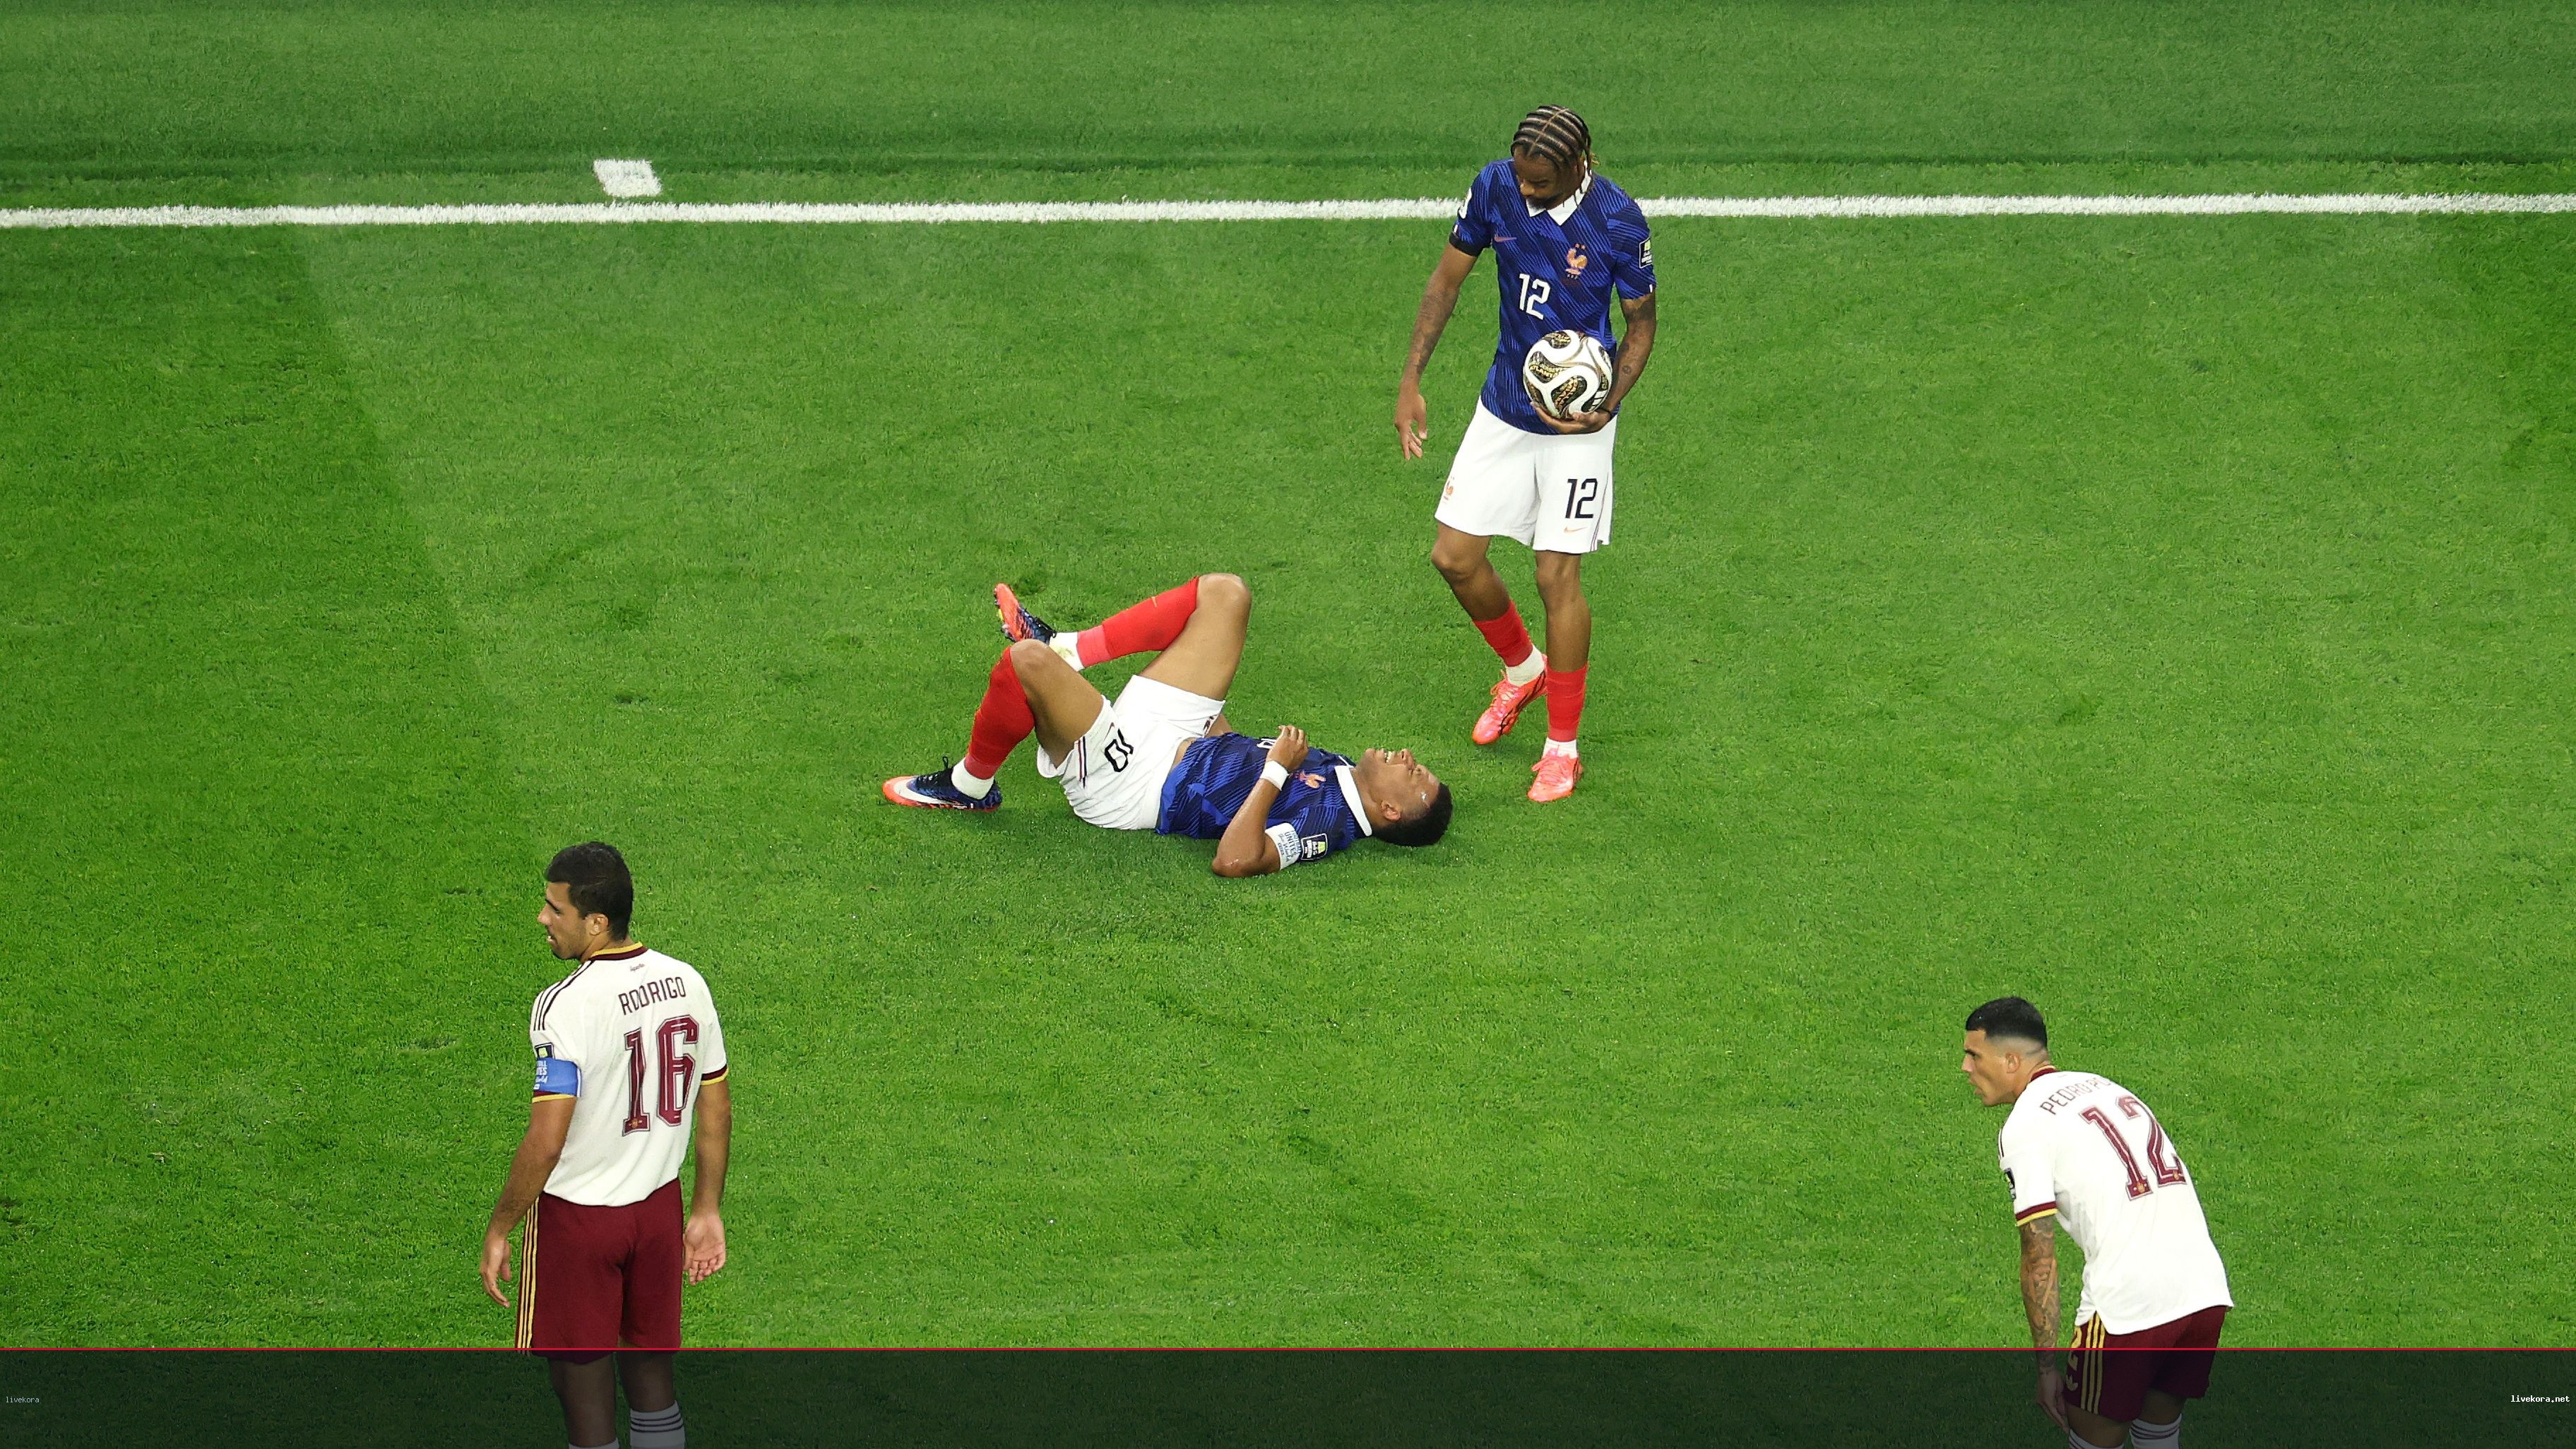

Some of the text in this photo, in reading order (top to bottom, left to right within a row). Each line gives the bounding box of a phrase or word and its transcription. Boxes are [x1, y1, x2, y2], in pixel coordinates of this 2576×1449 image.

[1519, 273, 1550, 320] 12
[1565, 478, 1598, 519] 12
[618, 976, 686, 1015] RODRIGO
[622, 1014, 699, 1137] 16
[2039, 1082, 2092, 1115] PEDRO
[2078, 1095, 2187, 1201] 12
